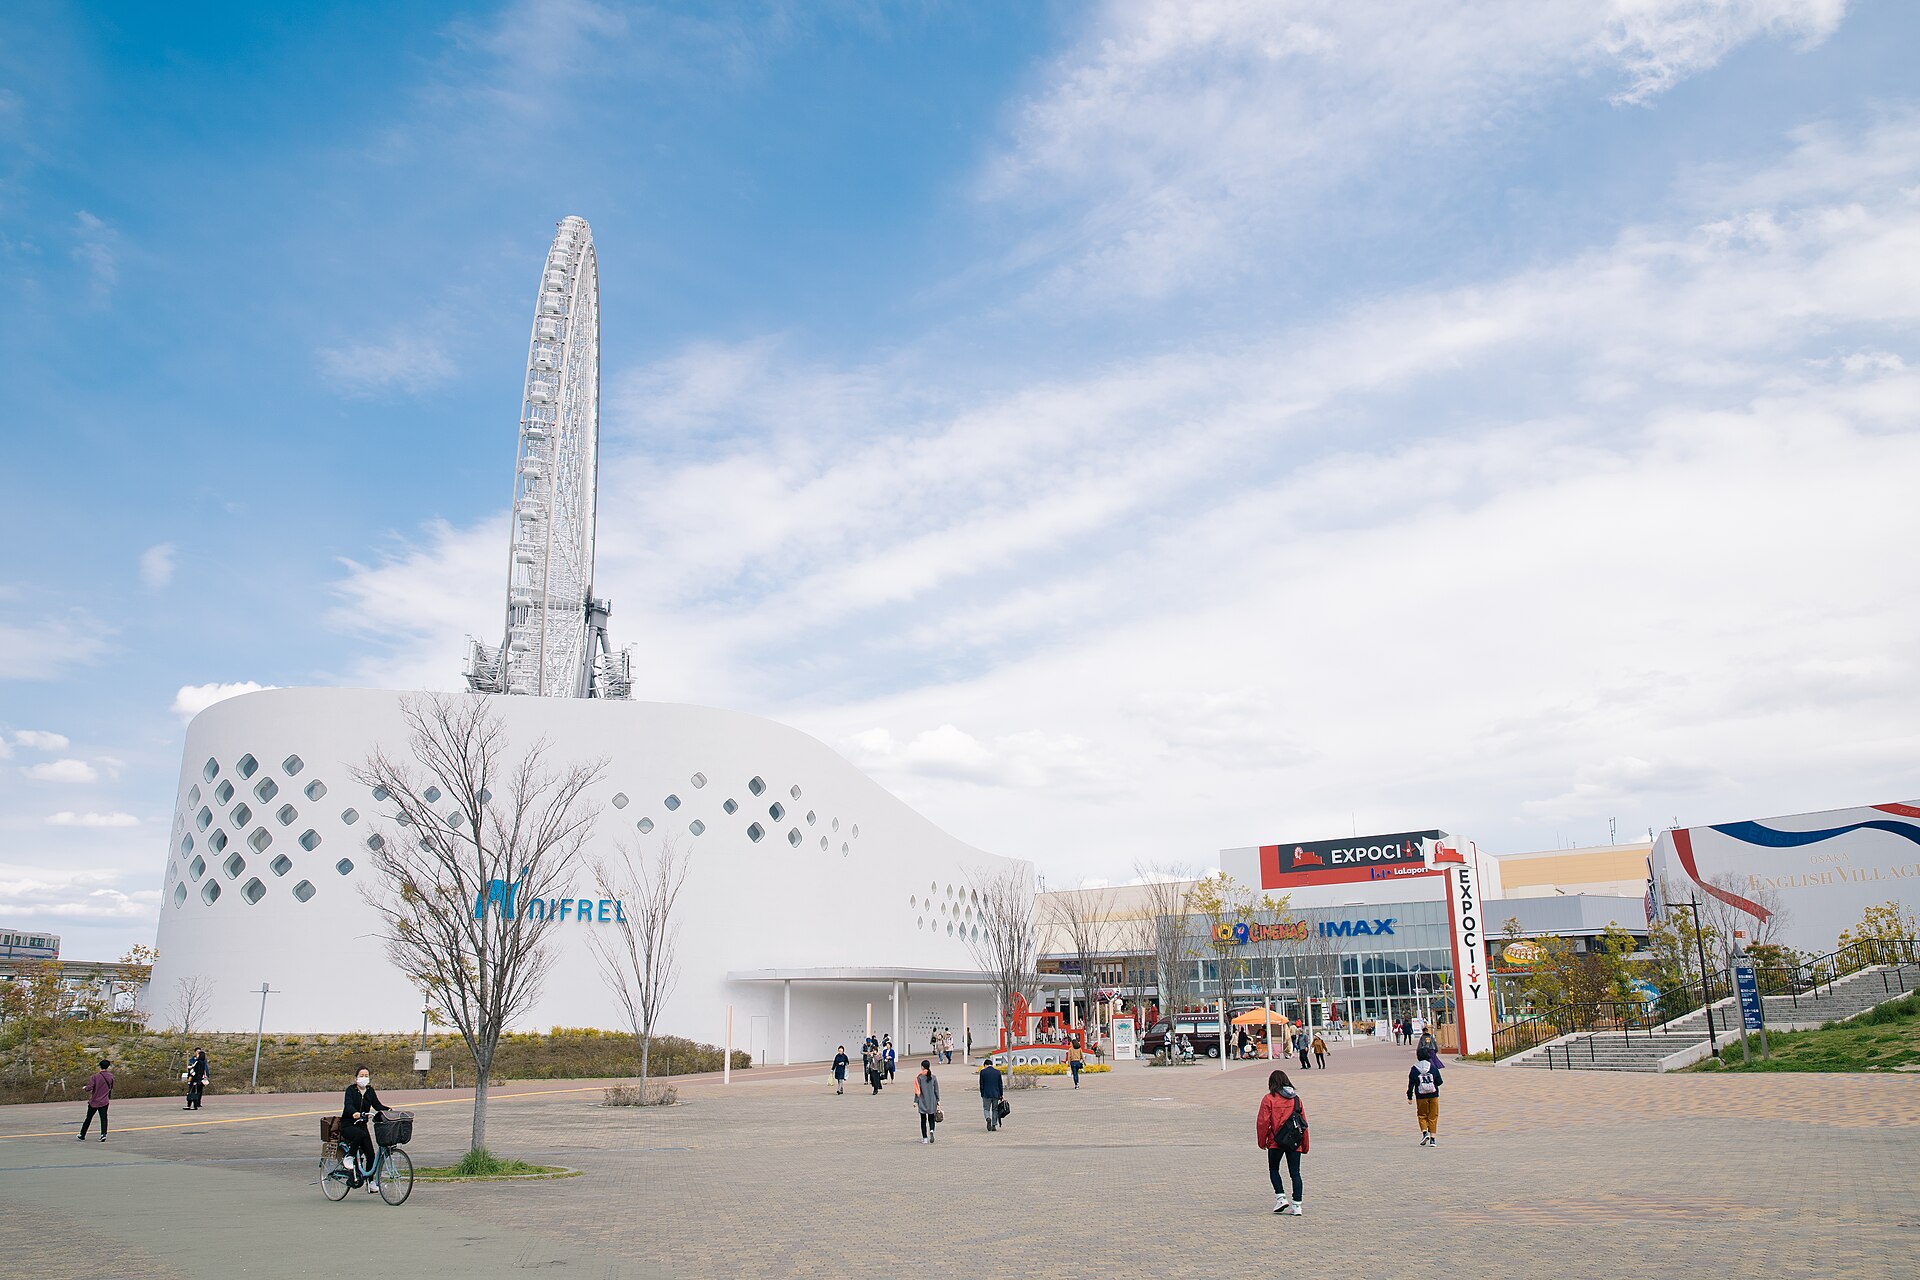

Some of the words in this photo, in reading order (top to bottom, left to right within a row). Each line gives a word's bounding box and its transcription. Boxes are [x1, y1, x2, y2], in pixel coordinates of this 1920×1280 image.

[1331, 839, 1424, 864] EXPOCITY
[1810, 853, 1849, 865] OSAKA
[1747, 872, 1833, 891] ENGLISH
[1249, 920, 1308, 942] CINEMAS
[1319, 919, 1395, 937] IMAX
[1459, 870, 1480, 998] EXPOCITY
